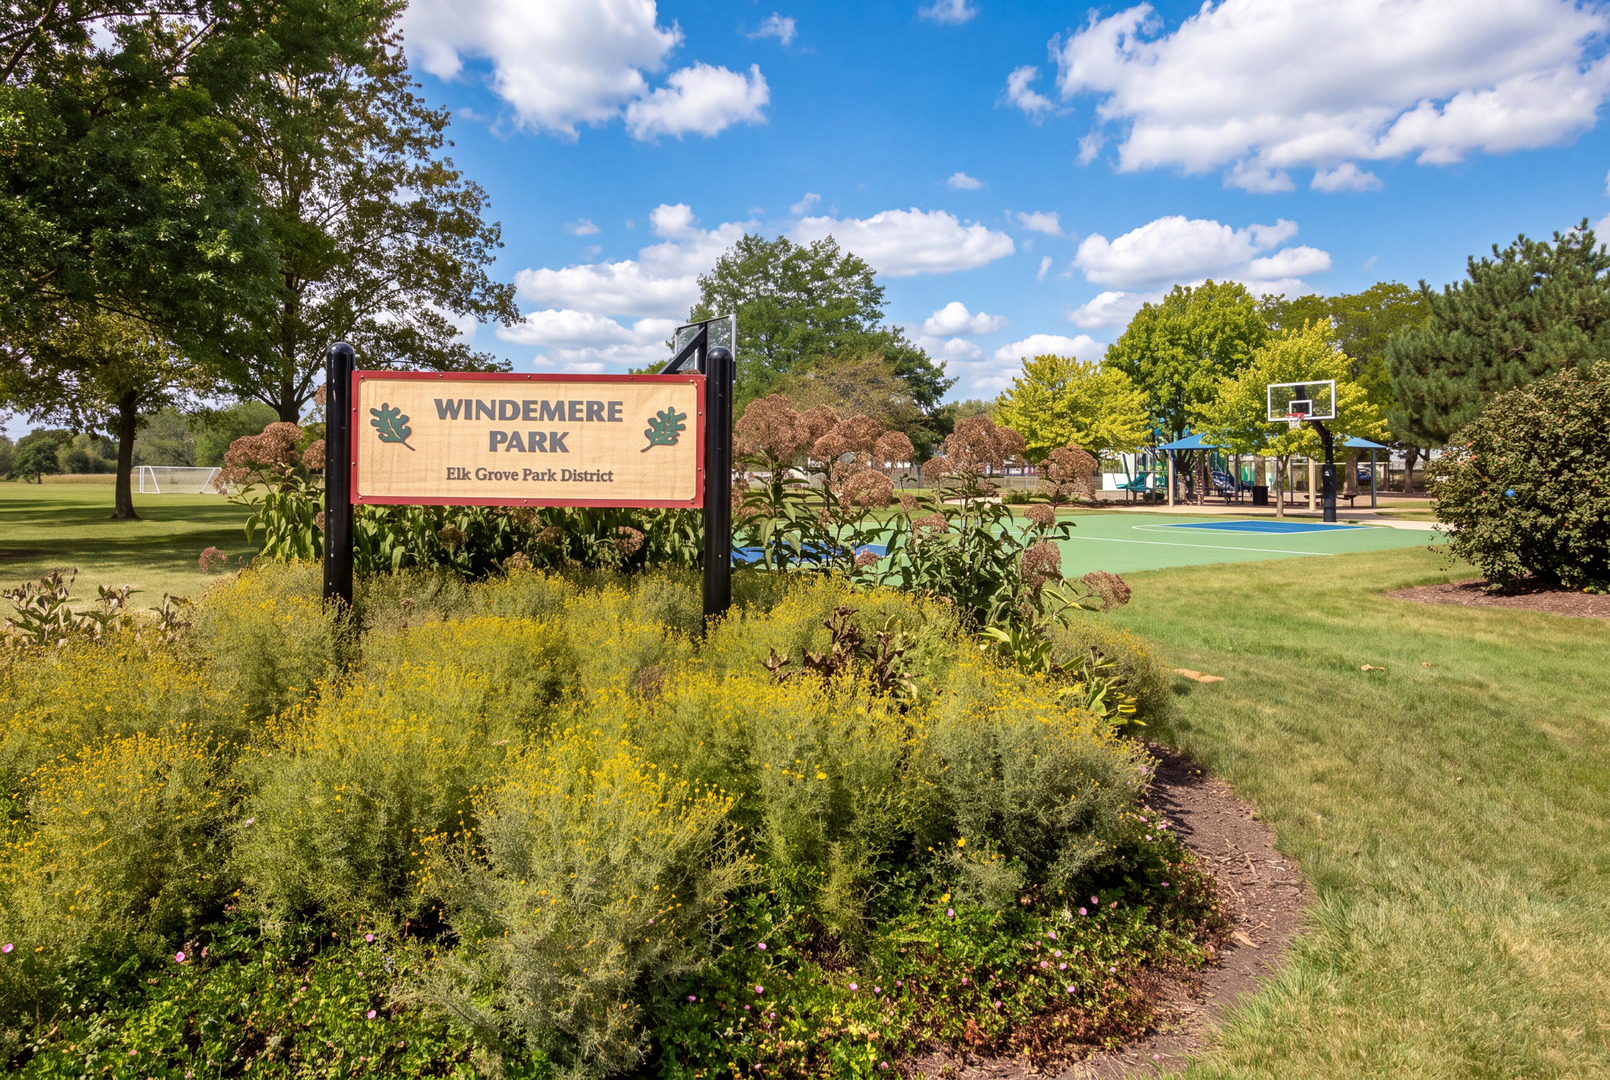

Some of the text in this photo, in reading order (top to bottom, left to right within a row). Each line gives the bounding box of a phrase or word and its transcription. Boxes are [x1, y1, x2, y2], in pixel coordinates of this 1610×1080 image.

[434, 398, 623, 422] WINDEMERE
[489, 431, 570, 453] PARK
[446, 467, 614, 483] Elk Grove Park District
